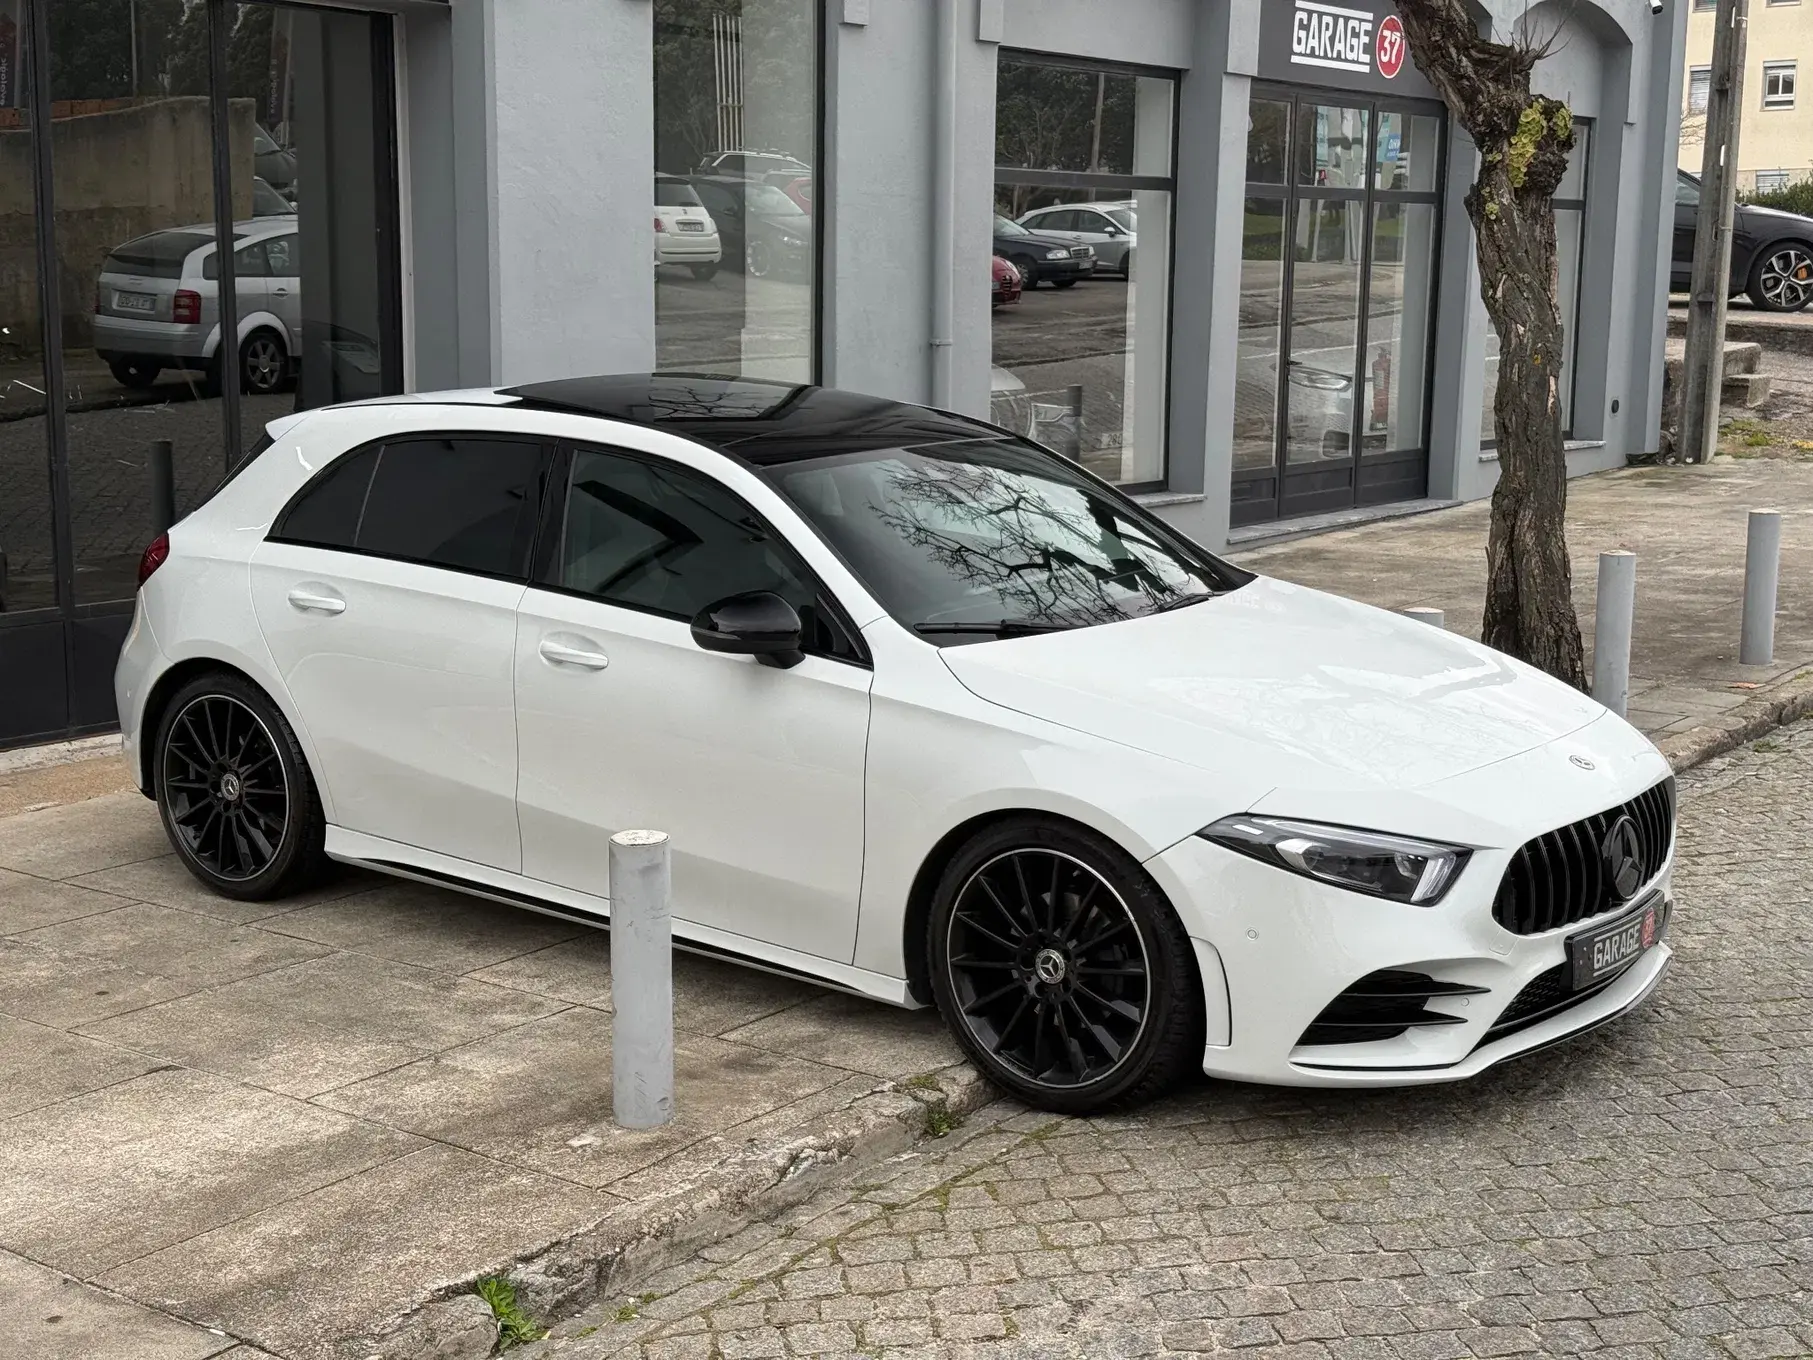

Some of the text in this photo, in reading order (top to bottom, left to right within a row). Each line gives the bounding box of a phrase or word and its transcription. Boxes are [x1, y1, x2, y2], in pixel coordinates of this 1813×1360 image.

[1293, 11, 1401, 64] GARAGE 37
[1594, 924, 1641, 970] GARAGE
